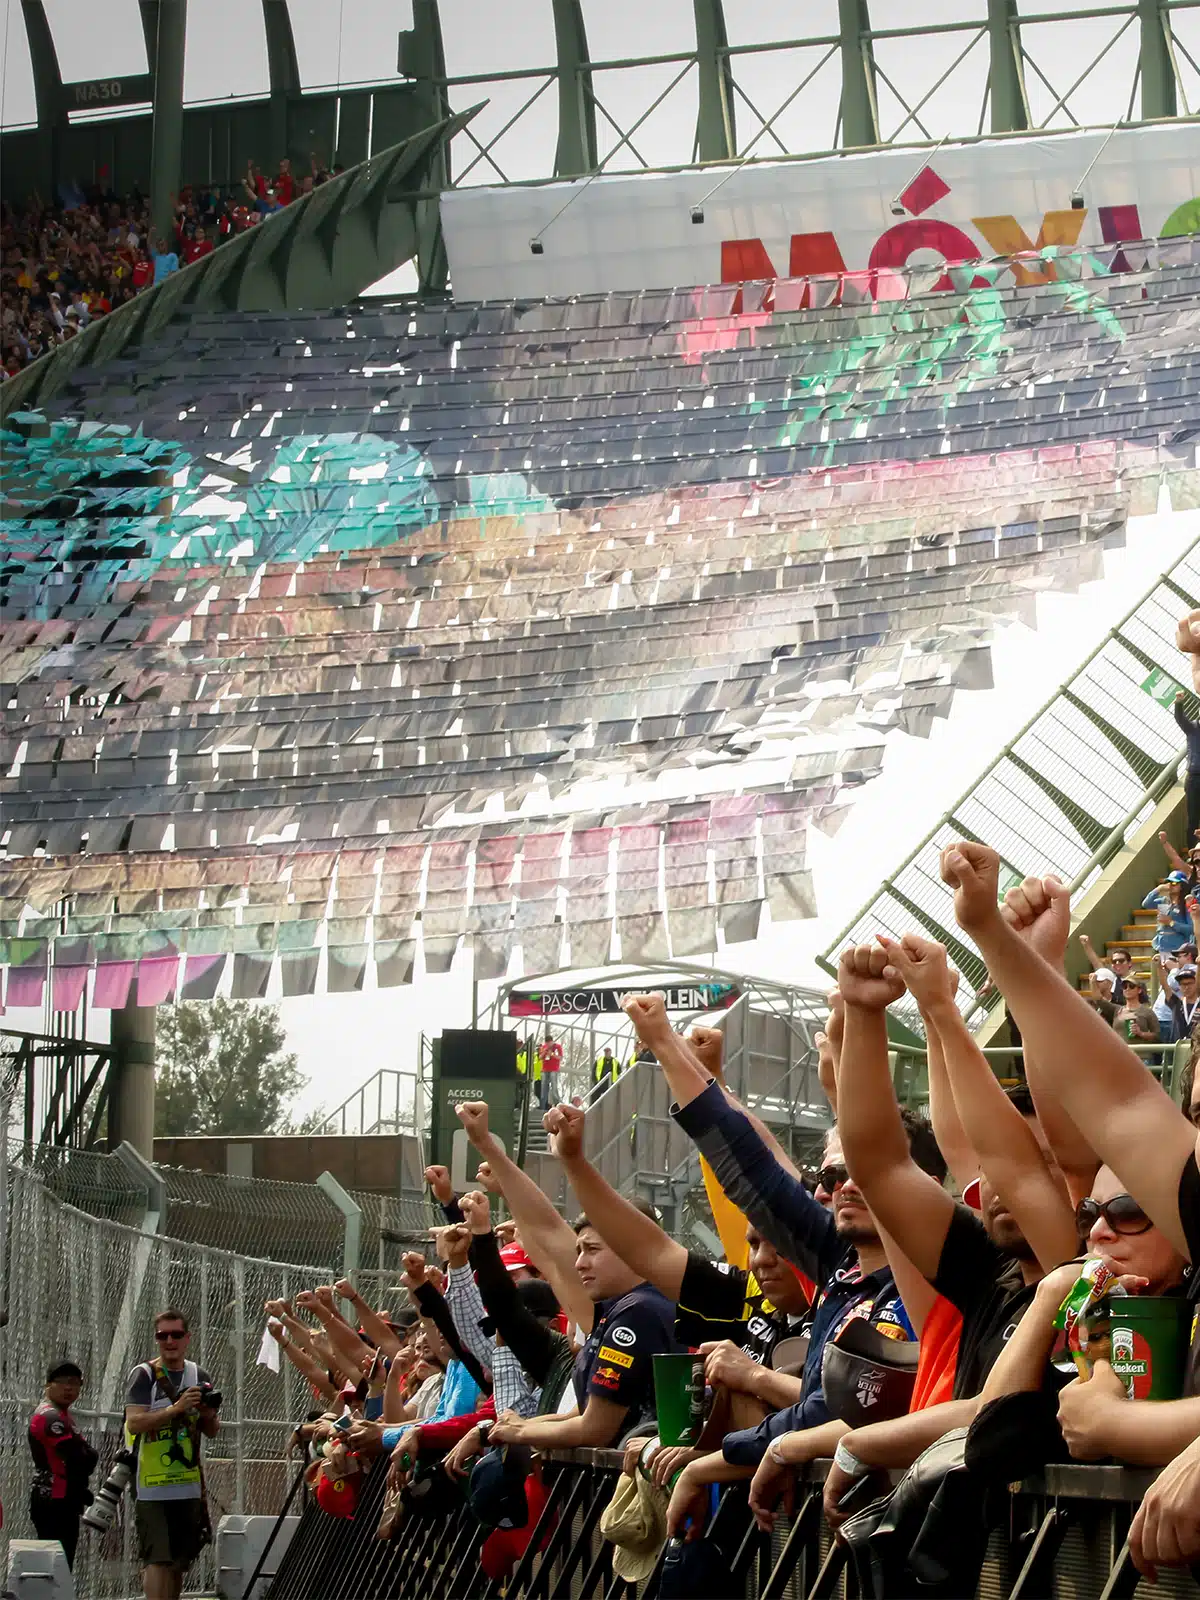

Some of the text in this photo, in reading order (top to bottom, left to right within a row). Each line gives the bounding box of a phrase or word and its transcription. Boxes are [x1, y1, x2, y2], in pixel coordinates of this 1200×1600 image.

[76, 82, 122, 104] NA30
[541, 991, 607, 1013] PASCAL
[447, 1089, 484, 1098] ACCESO
[615, 1329, 633, 1343] Esso
[858, 1379, 883, 1394] INTER
